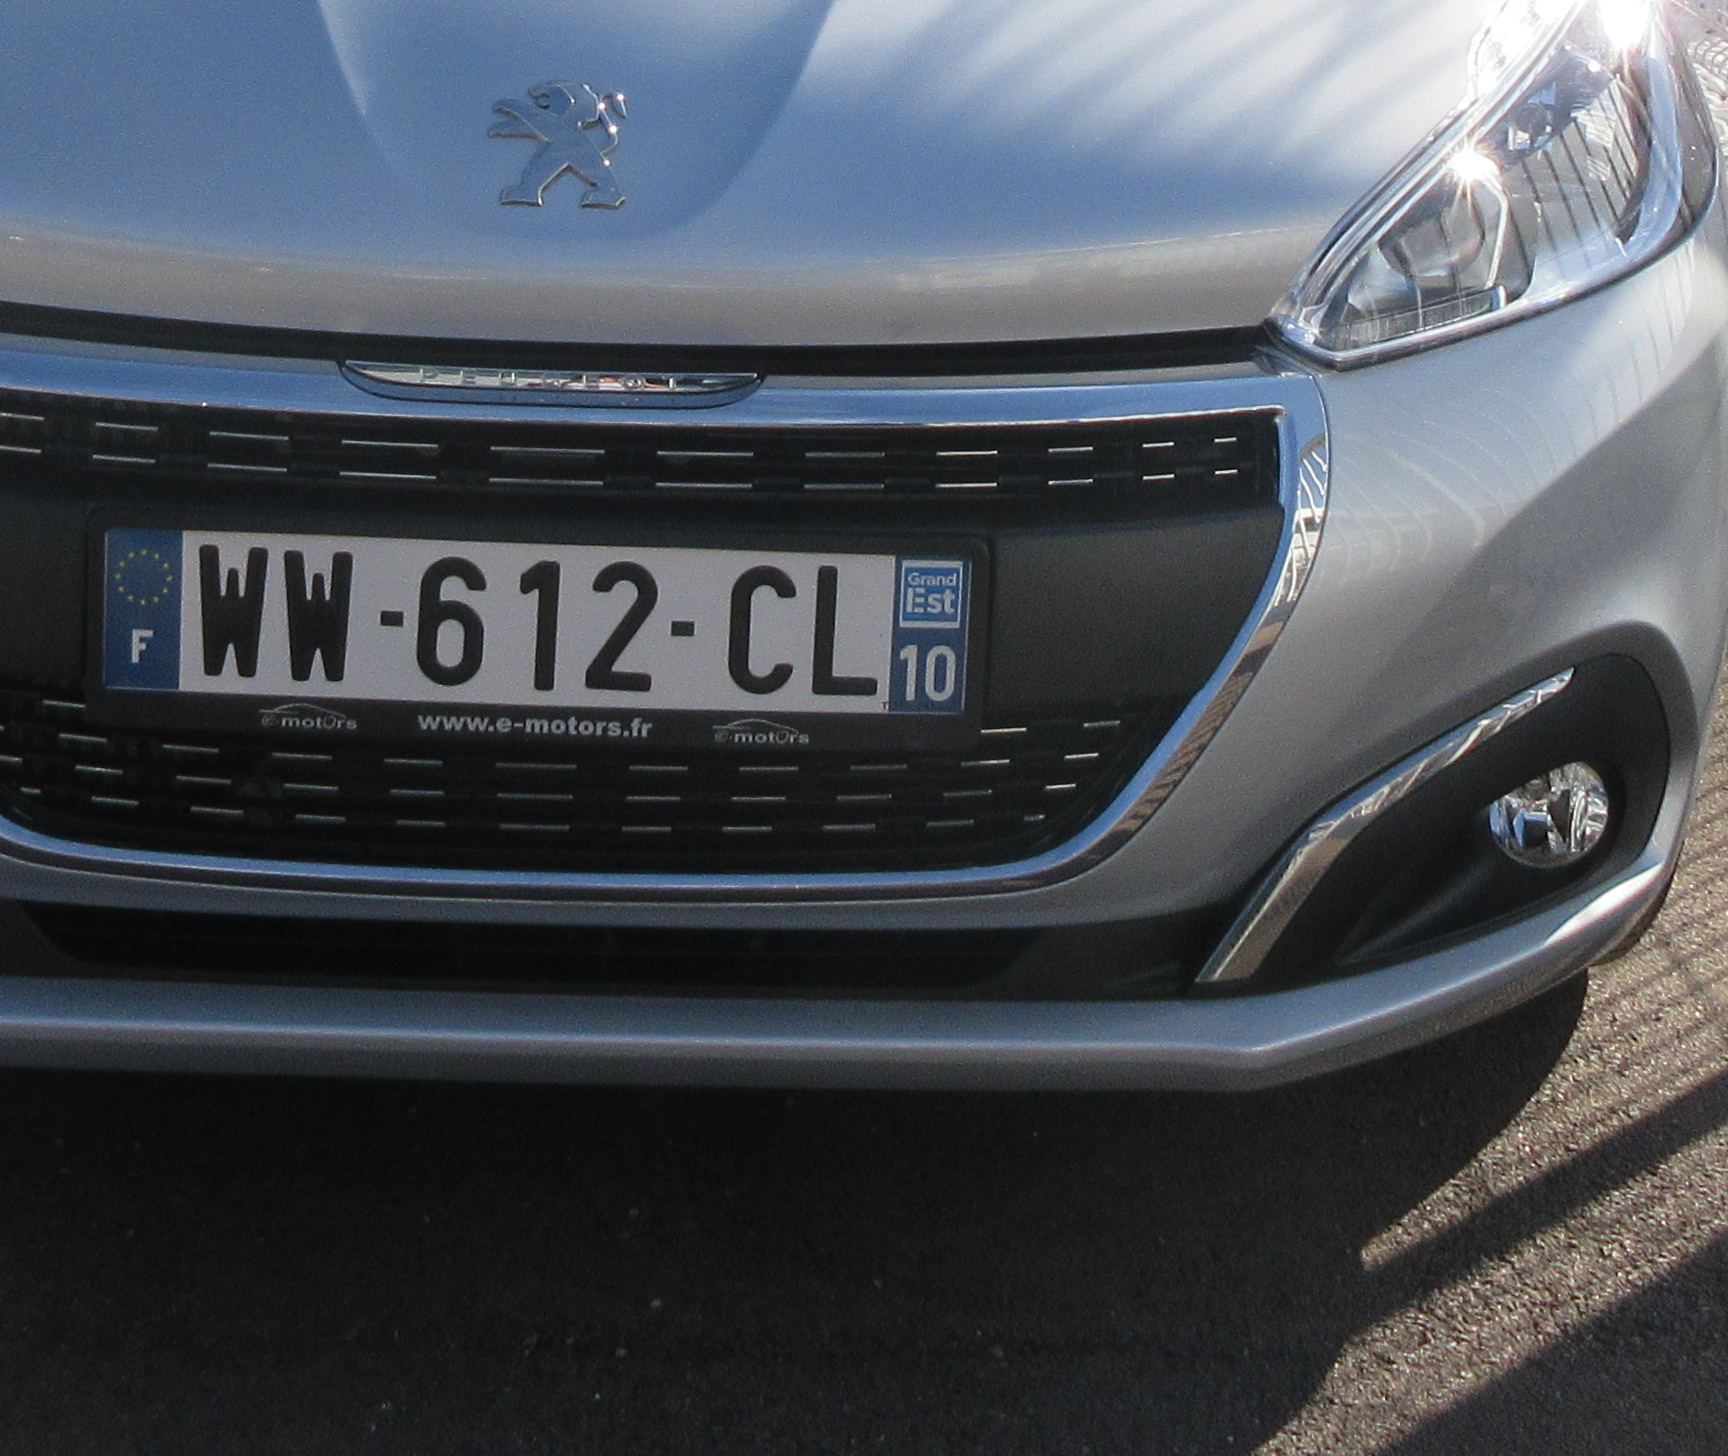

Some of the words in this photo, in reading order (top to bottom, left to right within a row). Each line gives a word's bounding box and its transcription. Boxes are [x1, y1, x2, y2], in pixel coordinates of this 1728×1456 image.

[907, 572, 958, 587] Grand
[905, 587, 956, 614] Est
[198, 544, 878, 696] WW-612-CL
[131, 628, 154, 664] F
[899, 644, 957, 702] 10
[417, 713, 653, 739] www.e-motors.fr
